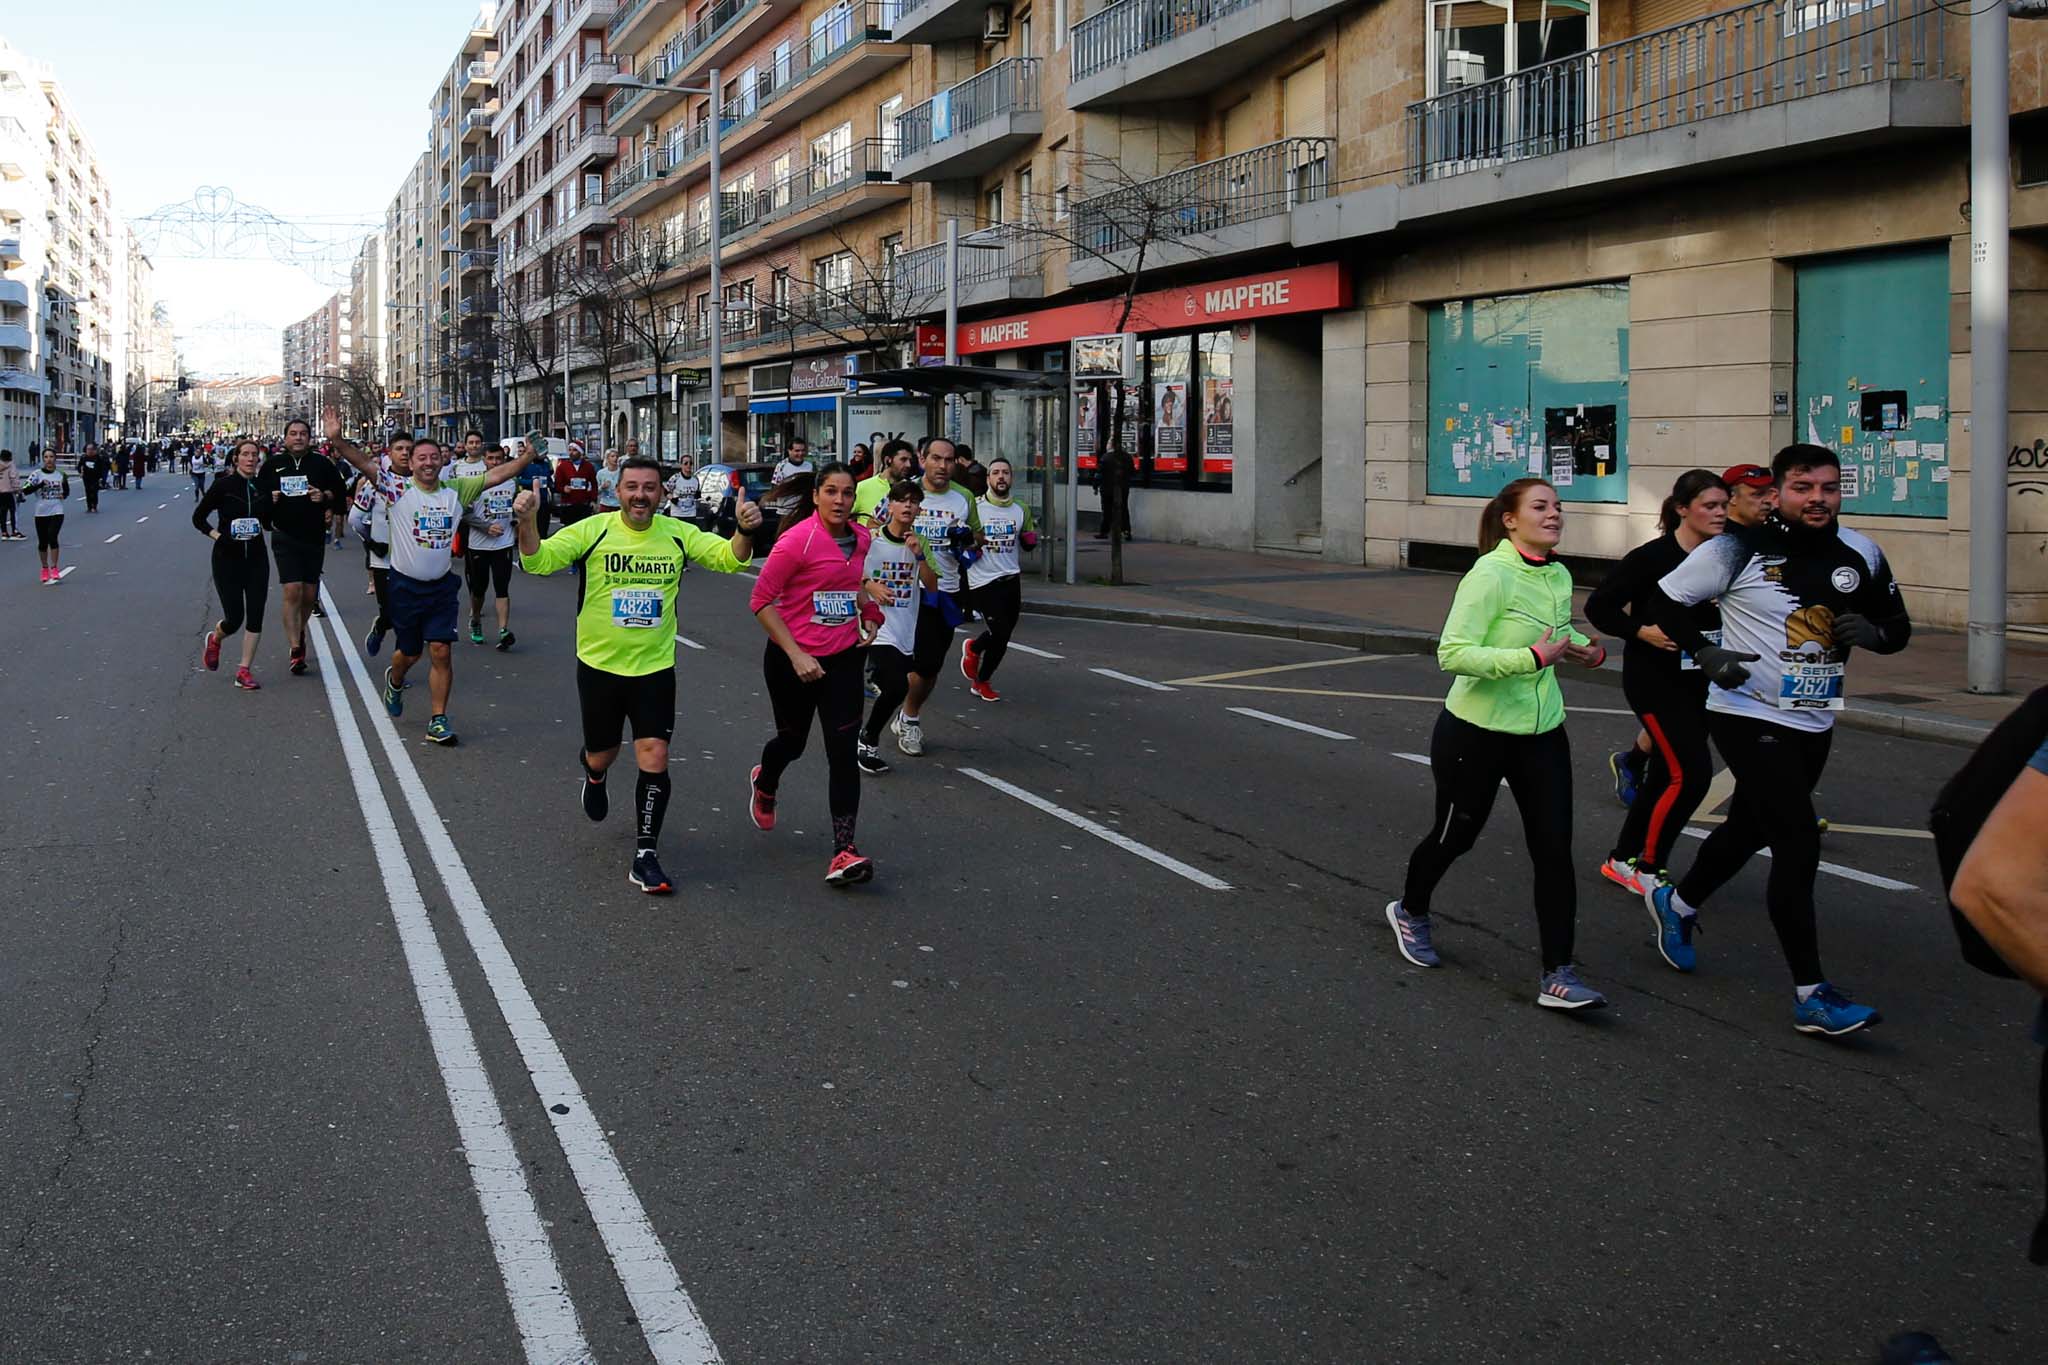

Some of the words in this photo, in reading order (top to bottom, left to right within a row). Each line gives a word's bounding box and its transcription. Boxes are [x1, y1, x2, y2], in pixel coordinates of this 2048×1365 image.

[1205, 279, 1289, 313] MAPFRE
[981, 321, 1029, 344] MAPFRE
[793, 376, 814, 389] Master
[425, 517, 444, 528] 4631
[990, 525, 1006, 534] 4531
[921, 526, 941, 537] 4133
[604, 553, 634, 574] 10K
[635, 562, 676, 574] MARTA
[619, 600, 652, 615] 4823
[820, 600, 848, 615] 6005
[1802, 666, 1839, 675] SETEL
[1792, 677, 1830, 695] 2621
